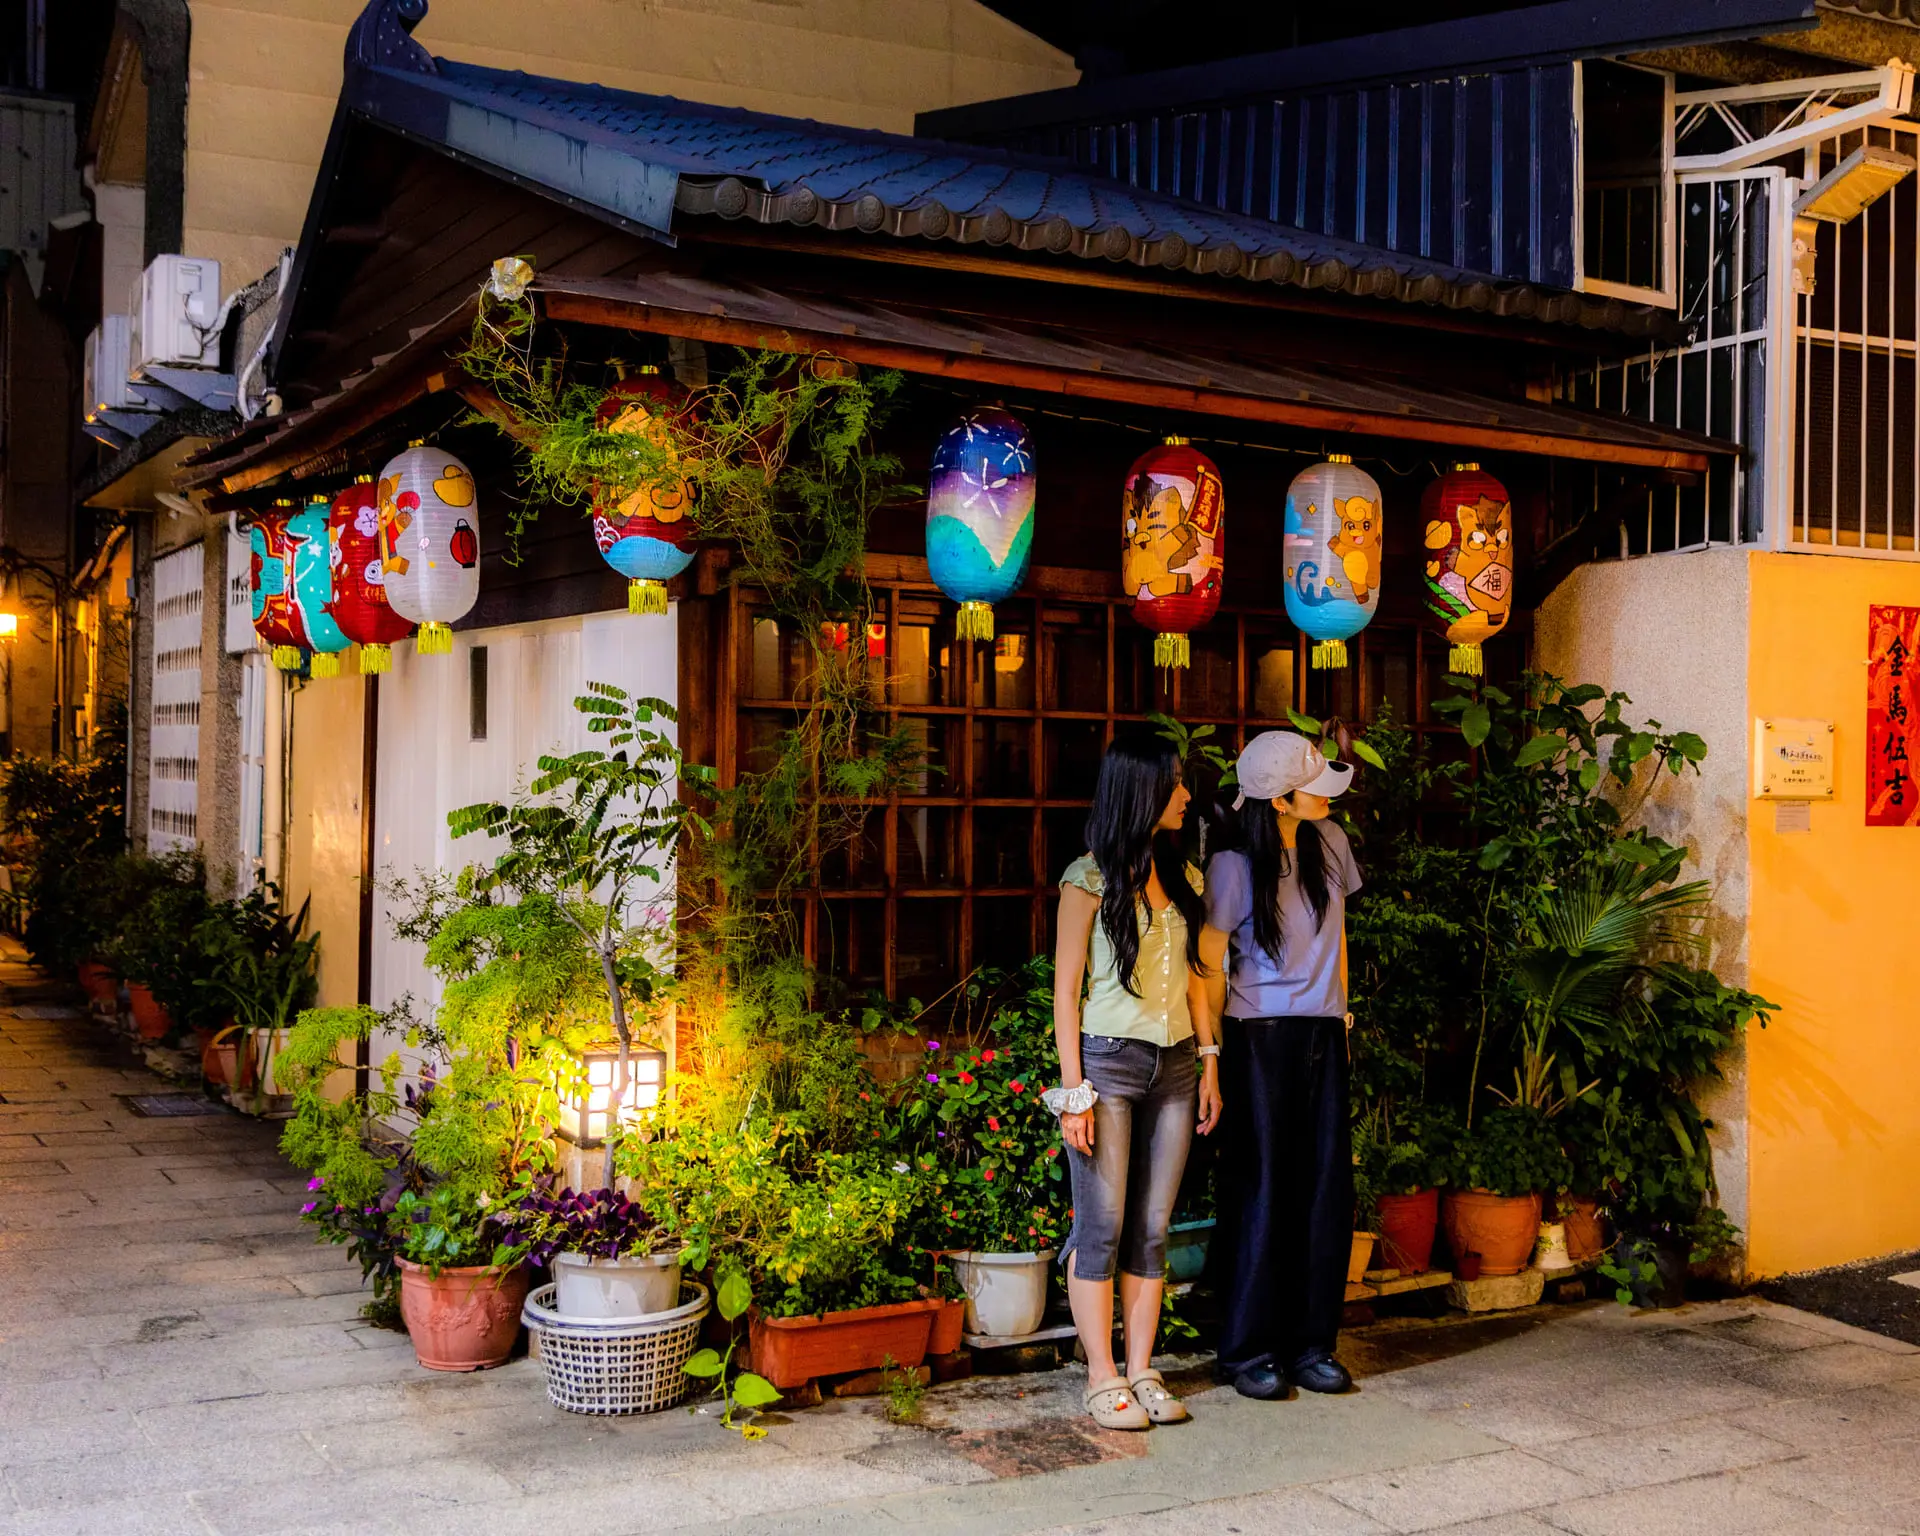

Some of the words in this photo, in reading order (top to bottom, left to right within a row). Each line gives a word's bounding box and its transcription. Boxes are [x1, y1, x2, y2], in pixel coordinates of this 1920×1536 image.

[1481, 568, 1502, 591] 福
[1882, 635, 1910, 806] 金馬伍吉
